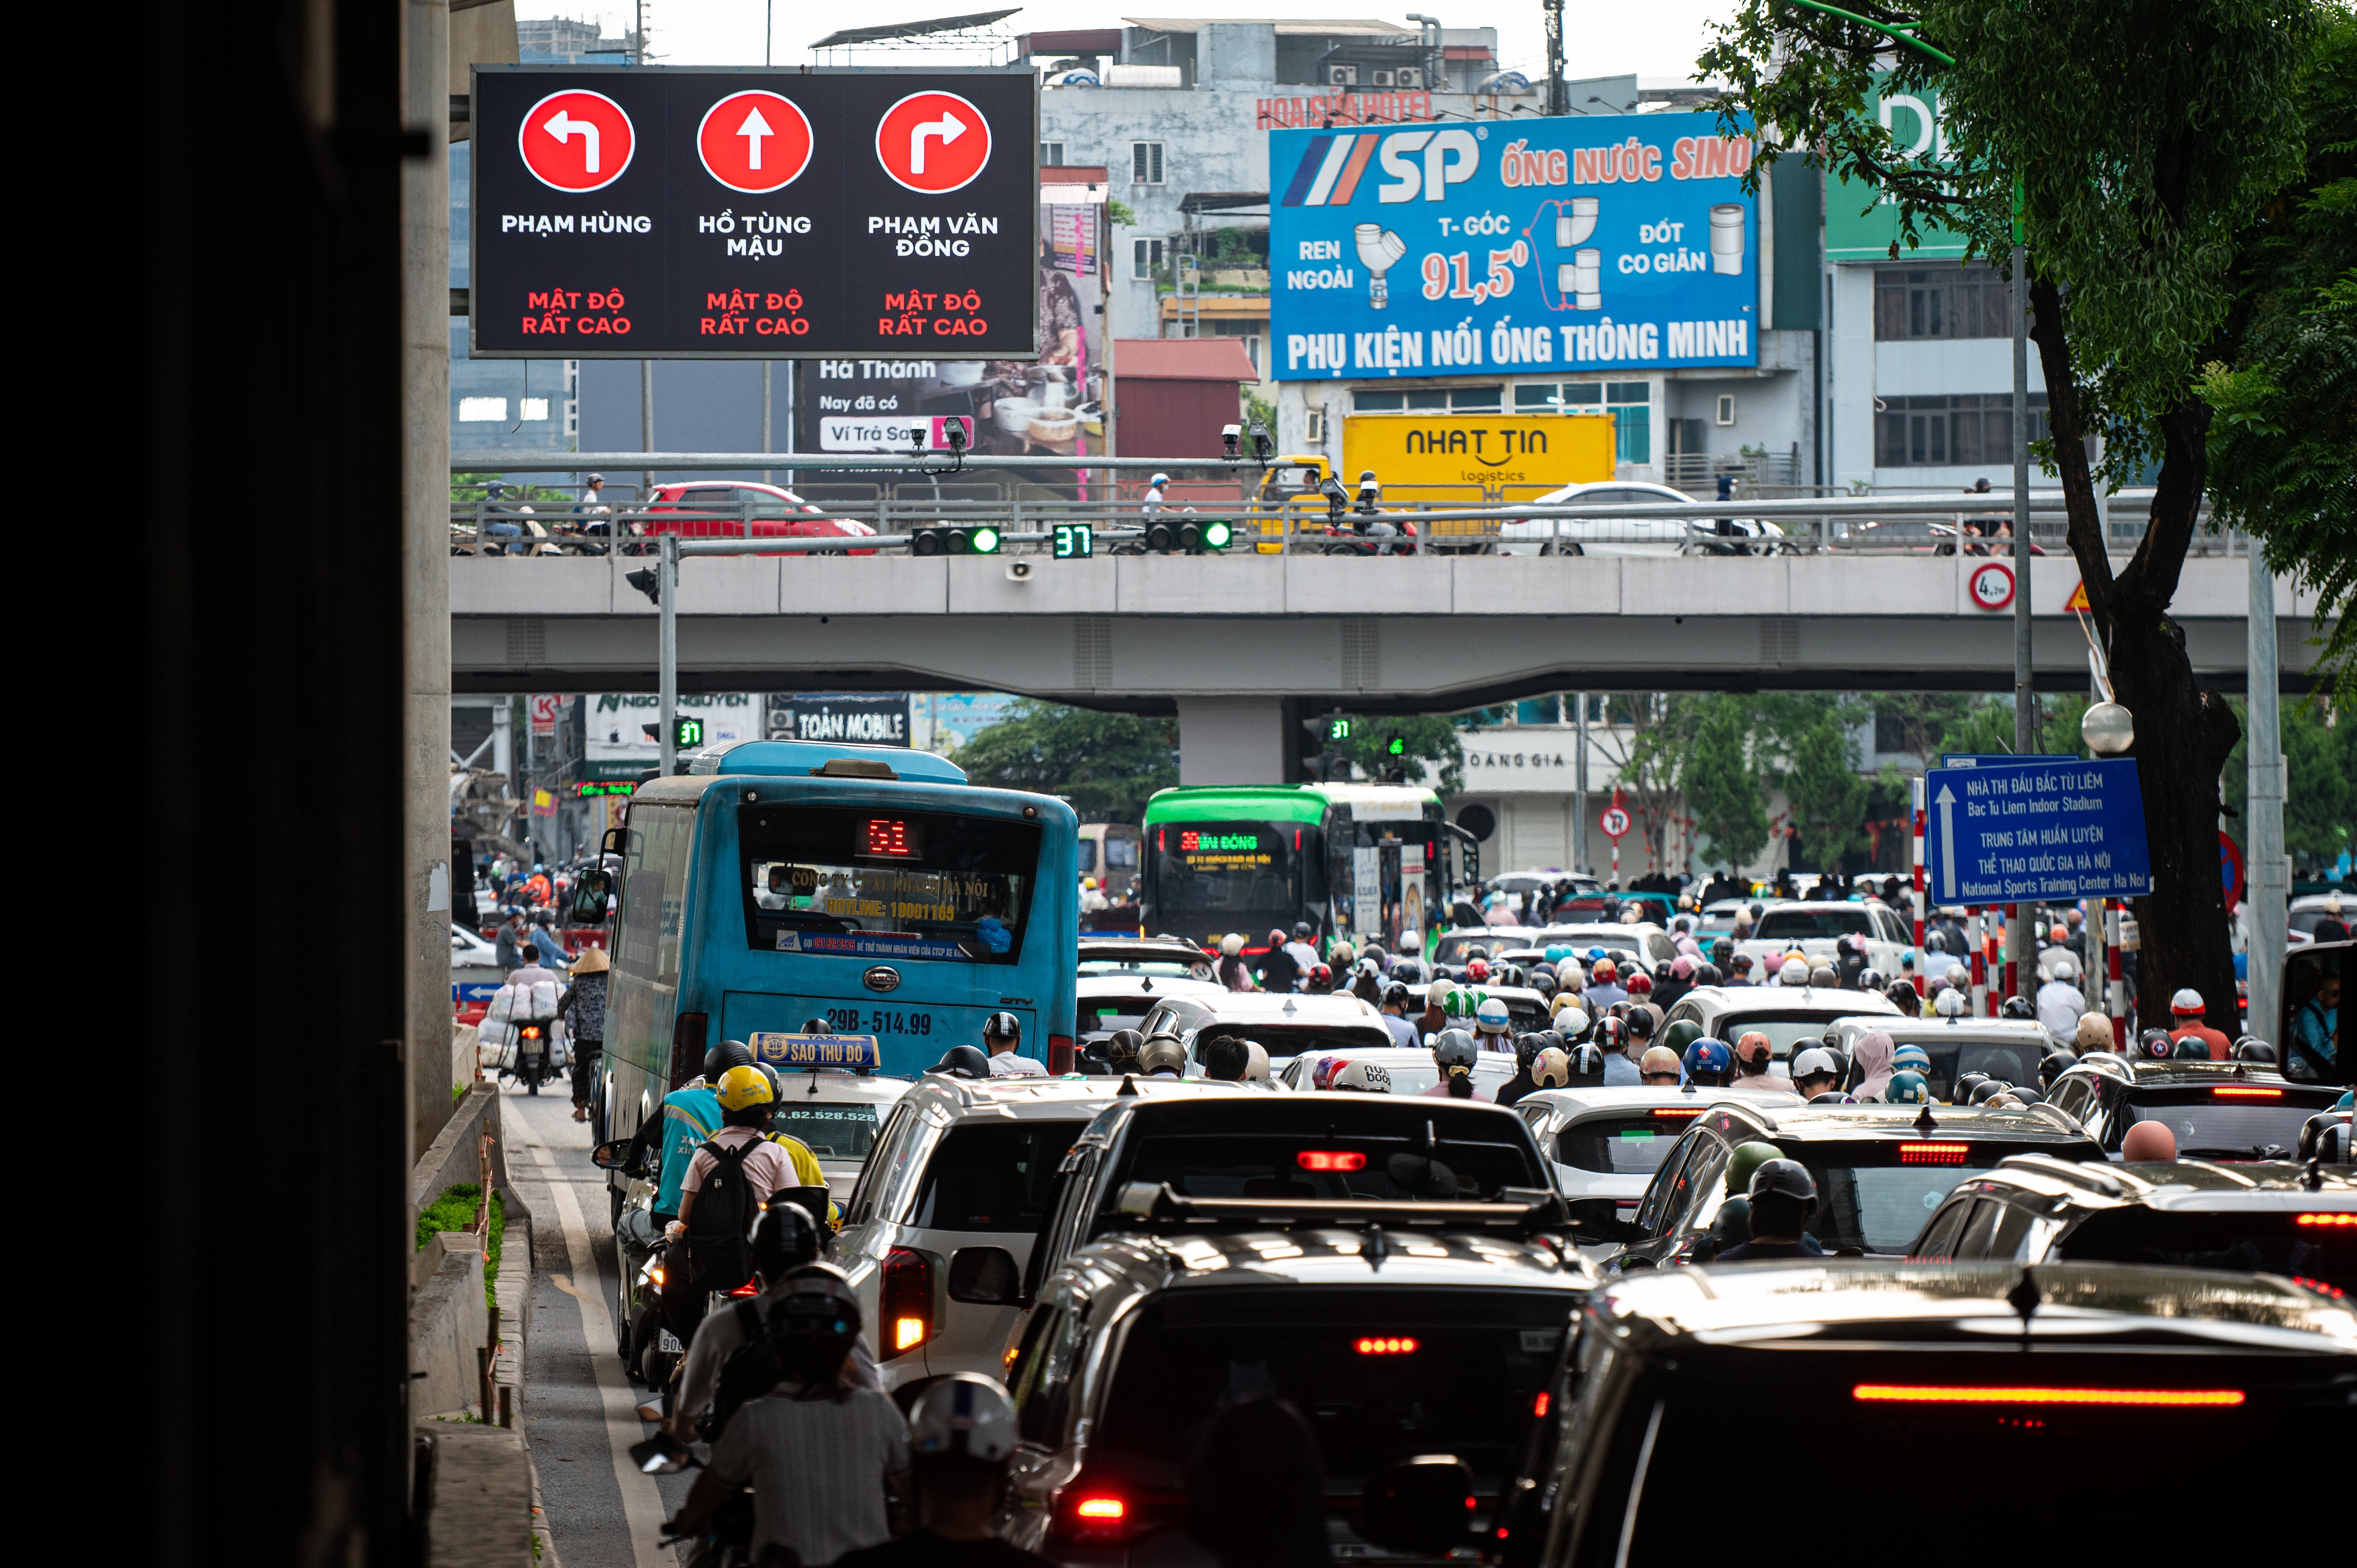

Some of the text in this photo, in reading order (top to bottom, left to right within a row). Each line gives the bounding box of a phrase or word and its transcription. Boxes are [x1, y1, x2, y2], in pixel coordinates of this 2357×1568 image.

[1257, 96, 1304, 130] HOA
[1364, 90, 1435, 124] HOTEL
[1500, 133, 1752, 188] ỐNG NƯỚC SINO
[502, 211, 652, 237] PHẠM HÙNG
[699, 208, 811, 234] HỒ TÙNG
[868, 212, 998, 239] PHẠM VĂN
[1464, 211, 1511, 236] GÓC
[1640, 217, 1684, 243] ĐỐT
[727, 235, 783, 261] MẬU
[896, 231, 970, 257] ĐỒNG
[1300, 240, 1340, 260] REN
[1618, 248, 1706, 274] CO GIÃN
[1288, 264, 1353, 289] NGOÀI
[529, 287, 625, 314] MẬT ĐỘ
[707, 288, 803, 315] MẬT ĐỘ
[885, 289, 981, 315] MẬT ĐỘ
[522, 309, 631, 334] RẤT CAO
[701, 310, 809, 335] RẤT CAO
[879, 311, 987, 336] RẤT CAO
[1288, 315, 1749, 377] PHỤ KIỆN NỐI ỐNG THÔNG MINH
[820, 395, 898, 412] Nay đã có
[832, 425, 910, 441] Ví Trả Sa
[1406, 429, 1547, 454] NHAT TIN
[1461, 470, 1525, 483] logistics
[1057, 526, 1091, 556] 37
[681, 721, 700, 744] 37
[846, 713, 903, 741] MOBILE
[1331, 719, 1349, 739] 37
[1462, 752, 1523, 767] OANG
[1967, 770, 2103, 797] NHÀ THI ĐẤU BẮC TỪ LIÊM
[1968, 796, 2103, 817] Bac Tu Liem Indoor Stadium
[1980, 823, 2103, 849] TRUNG TÂM HUẤN LUYỆN
[1978, 850, 2111, 875] THỂ THAO QUỐC GIA HÀ NỘI
[791, 868, 828, 888] CÔNG
[831, 873, 849, 888] TY
[942, 876, 961, 896] HÀ
[964, 878, 988, 900] NỘI
[1962, 872, 2146, 899] National Sports Training Center Ha Noi
[827, 898, 955, 921] HOTLINE: 19001165
[803, 939, 813, 950] GỌI
[857, 939, 864, 952] ĐỂ
[865, 940, 875, 952] TRỞ
[875, 941, 892, 953] THÀNH
[893, 942, 907, 954] NHÂN
[908, 944, 920, 955] VIÊN
[920, 944, 931, 955] CỦA
[932, 947, 945, 956] CTCP
[946, 948, 953, 957] XE
[867, 974, 897, 983] SAMCO
[826, 1008, 860, 1031] 29B
[872, 1011, 931, 1036] 514.99
[791, 1040, 863, 1062] SAO THỦ ĐÔ
[775, 1111, 877, 1122] 4.62.528.528
